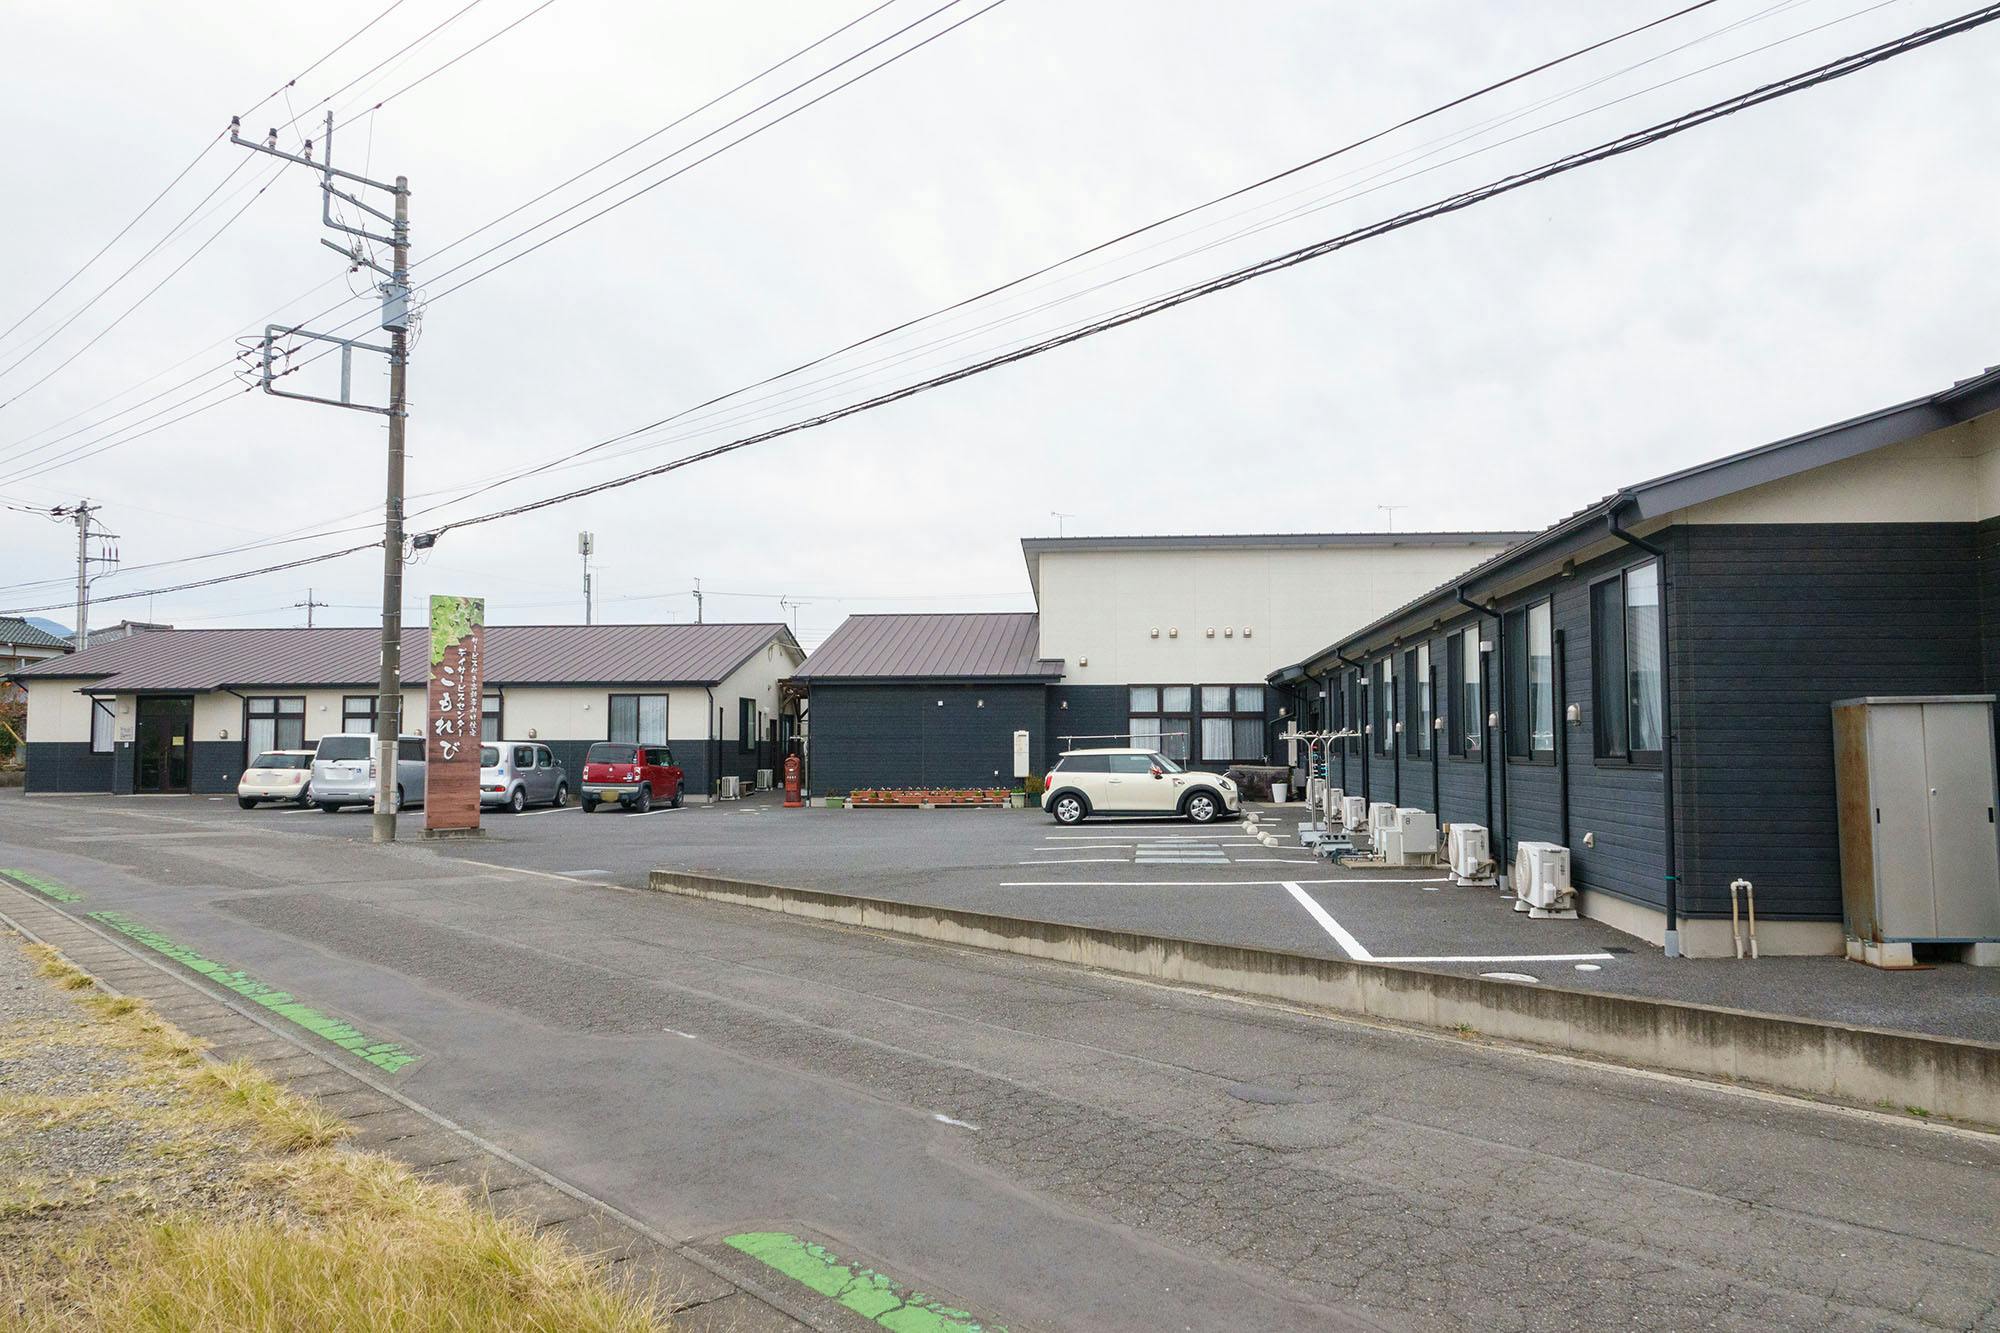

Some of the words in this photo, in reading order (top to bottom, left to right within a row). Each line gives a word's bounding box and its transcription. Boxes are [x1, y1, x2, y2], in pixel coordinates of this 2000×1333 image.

[435, 666, 460, 760] こもれび
[456, 648, 467, 737] デイサービスセンター
